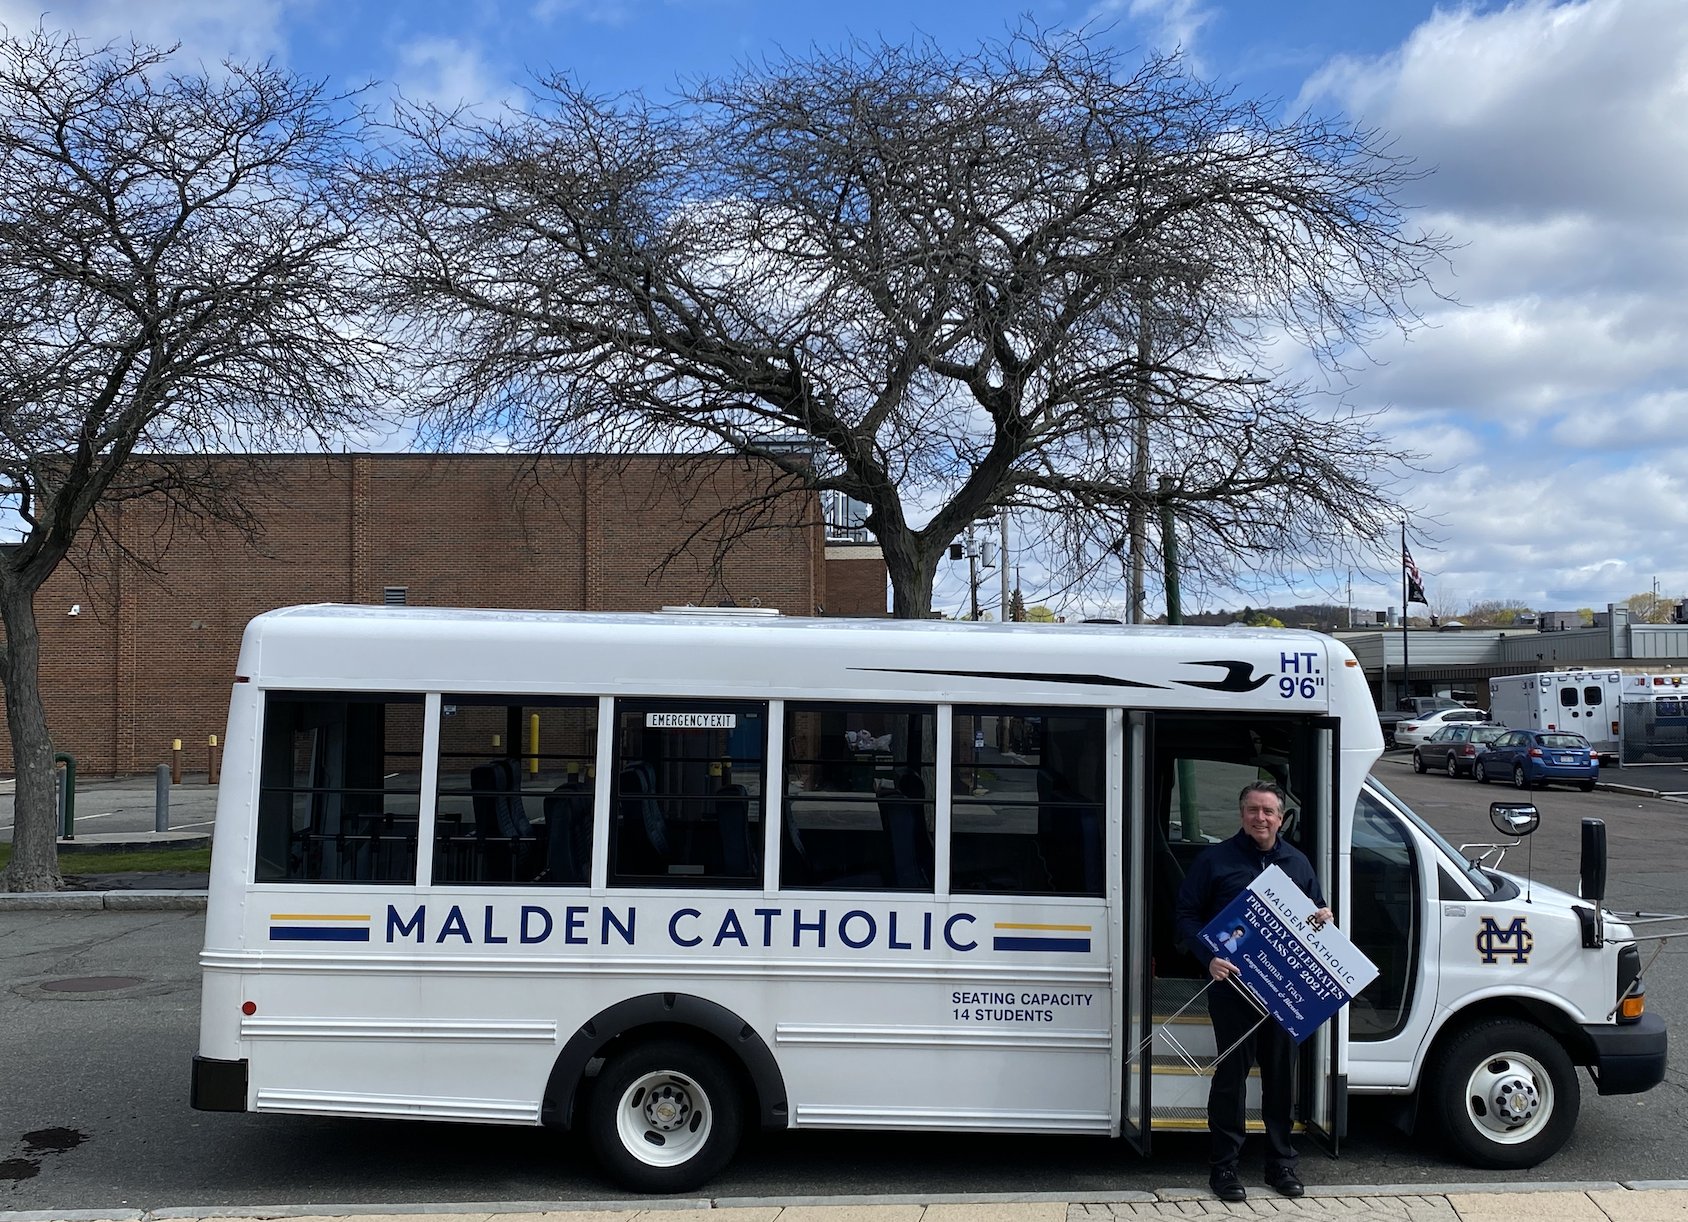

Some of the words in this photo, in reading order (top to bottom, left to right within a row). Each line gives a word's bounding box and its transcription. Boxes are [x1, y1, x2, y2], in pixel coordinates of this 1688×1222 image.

[1280, 652, 1320, 674] HT.
[1279, 677, 1324, 699] 9'6"
[652, 714, 709, 727] EMERGENCY
[711, 715, 731, 727] EXIT
[386, 905, 636, 946] MALDEN
[668, 908, 979, 952] CATHOLIC
[1246, 895, 1290, 940] PROUDLY
[1287, 940, 1345, 1000] CELEBRATES
[1264, 888, 1305, 931] MALDEN
[1306, 933, 1355, 985] CATHOLIC
[1243, 953, 1279, 993] Congratulations
[1244, 908, 1261, 928] The
[1260, 927, 1289, 957] CLASS
[1286, 956, 1303, 970] OF
[1300, 970, 1331, 1001] 2021!
[1256, 950, 1284, 981] Thomas
[1284, 980, 1305, 1004] Tracy
[952, 992, 1016, 1005] SEATING
[1021, 993, 1093, 1006] CAPACITY
[953, 1008, 970, 1021] 14
[975, 1009, 1053, 1022] STUDENTS
